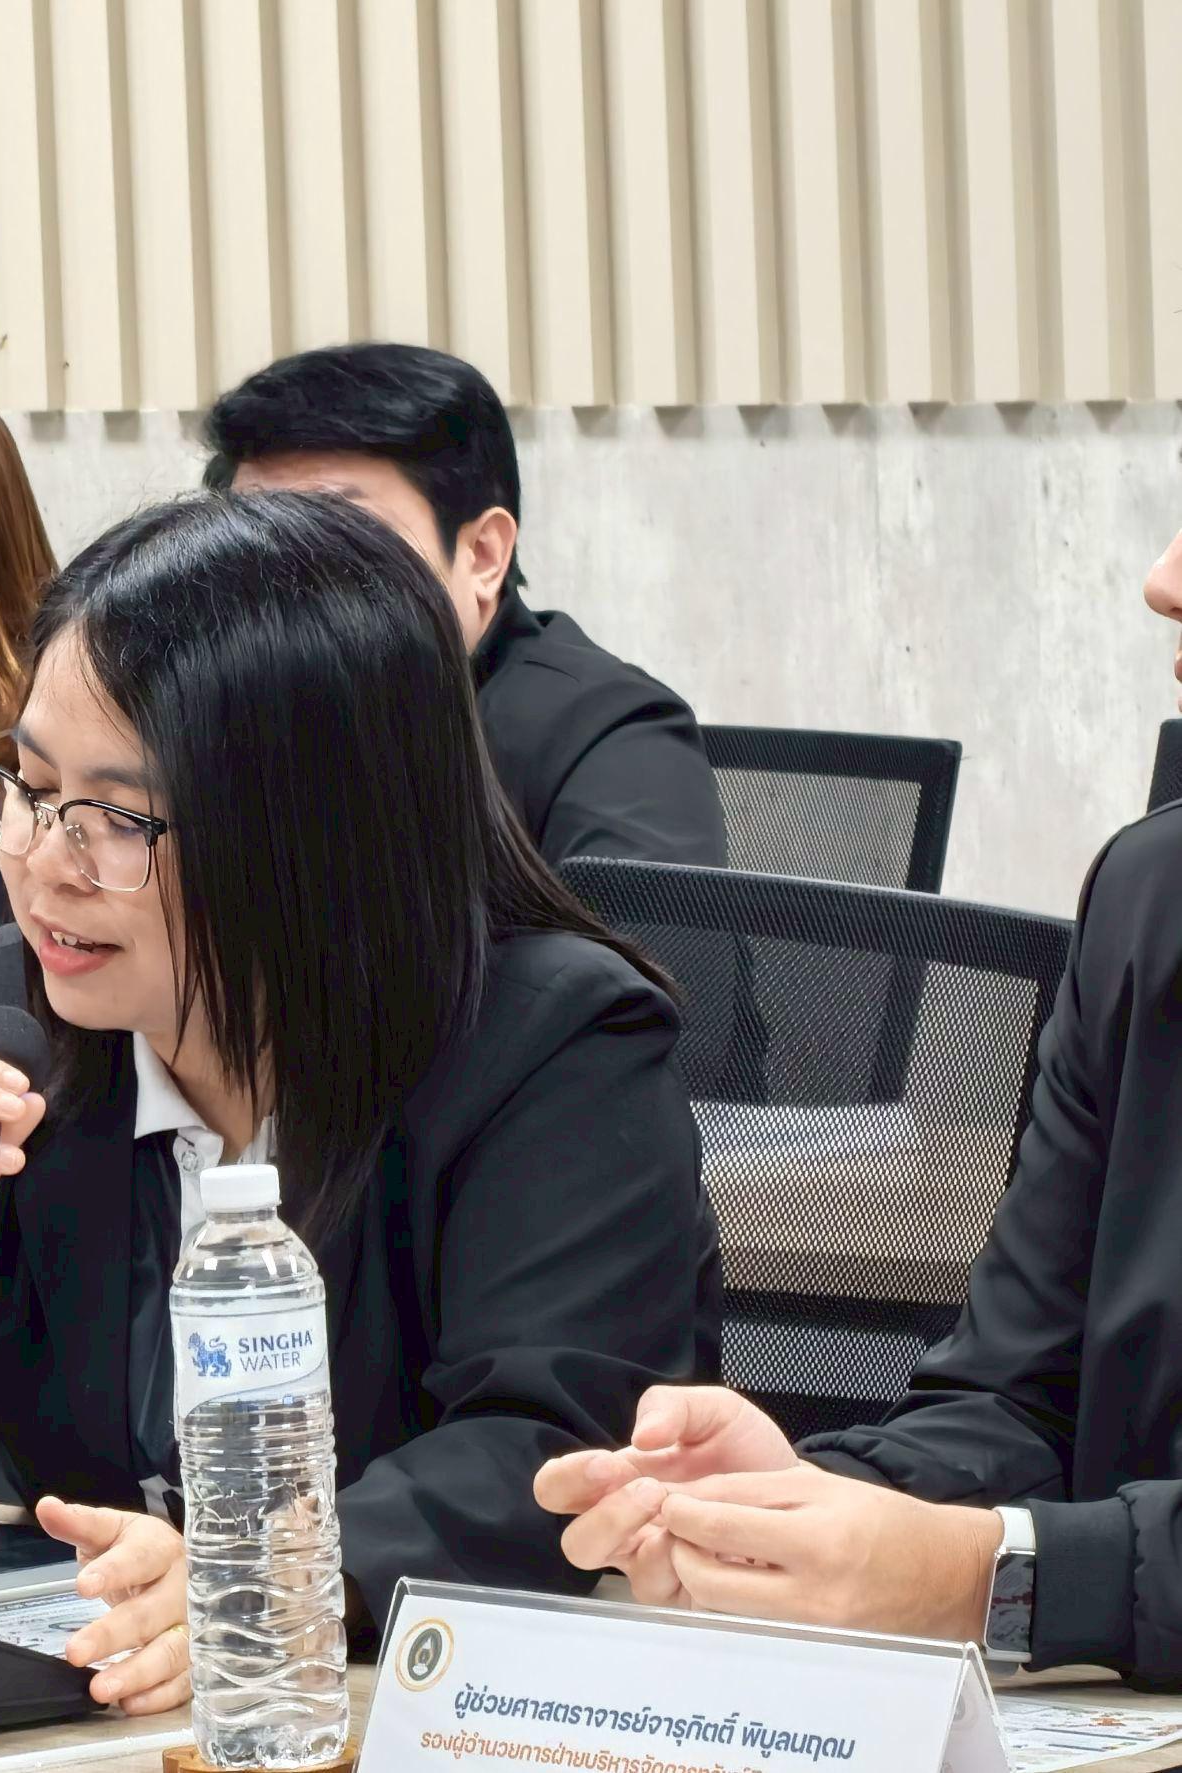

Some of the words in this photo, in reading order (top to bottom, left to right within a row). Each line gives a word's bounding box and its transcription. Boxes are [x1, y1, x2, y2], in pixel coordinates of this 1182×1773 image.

[238, 1331, 313, 1353] SINGHA
[240, 1352, 301, 1372] WATER
[741, 1722, 856, 1761] พิบูลนฤดม
